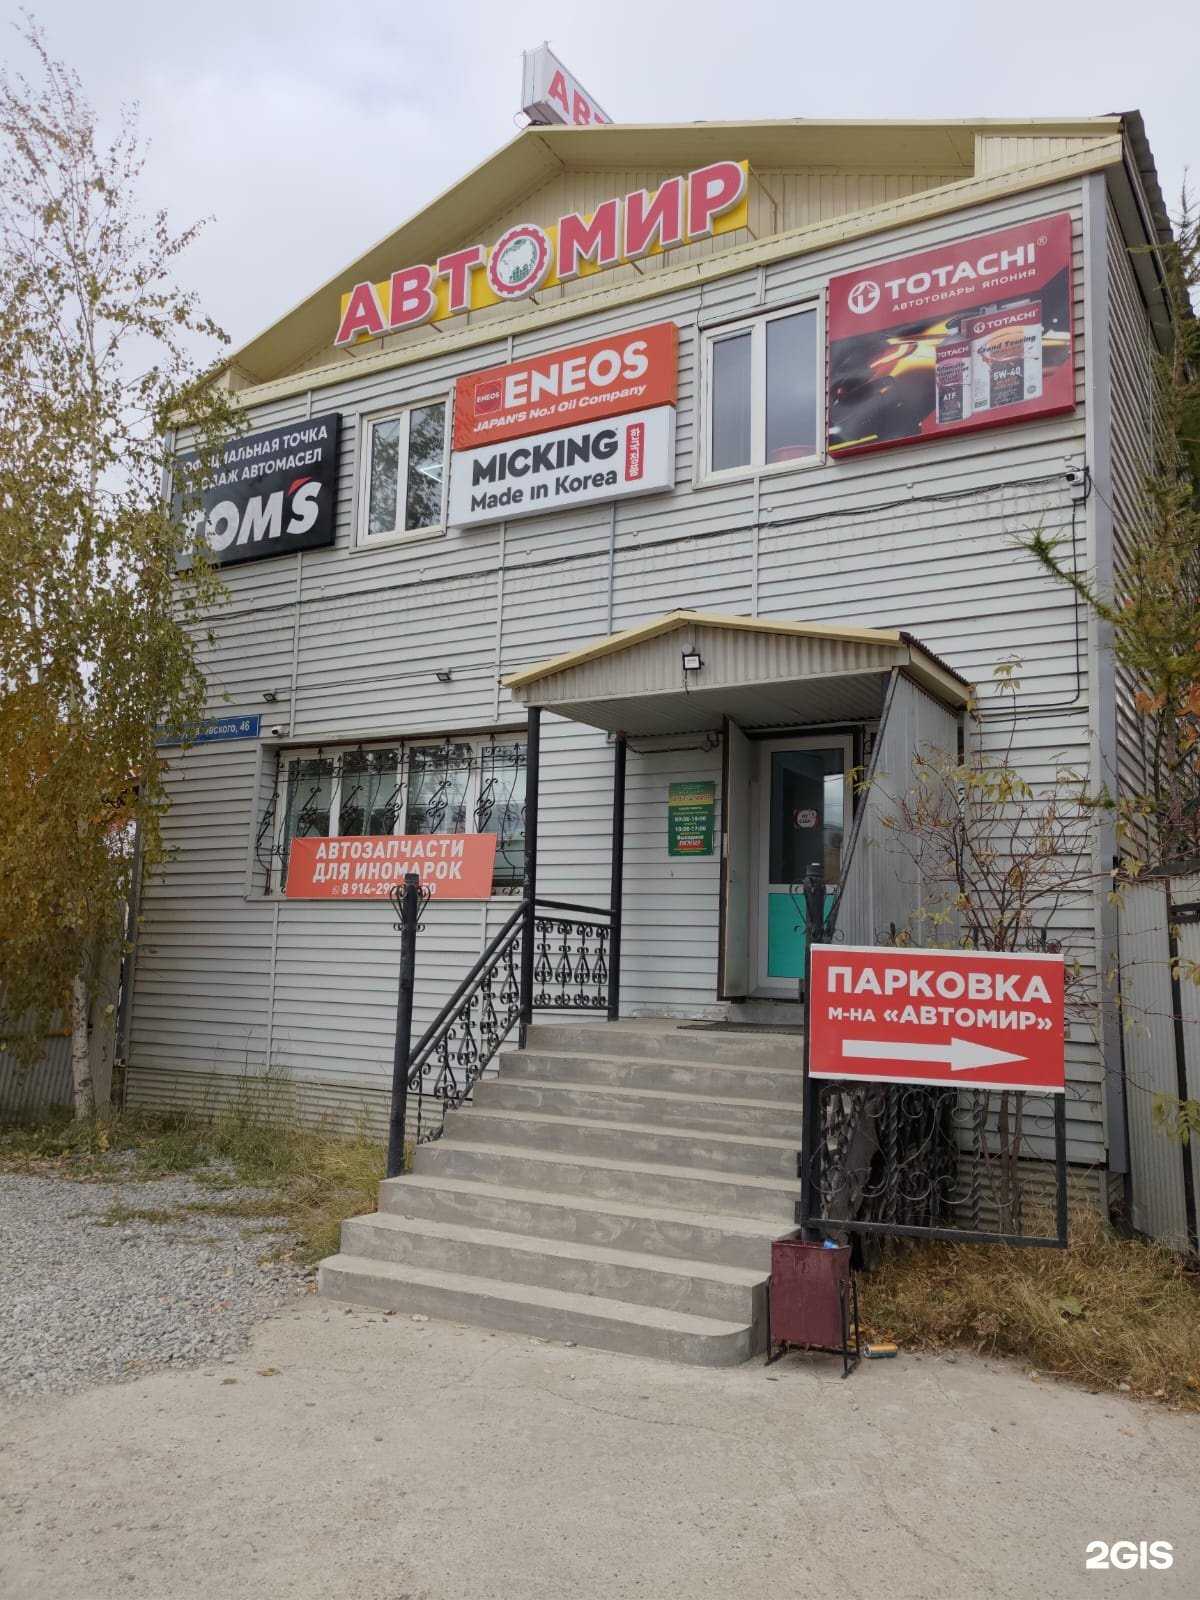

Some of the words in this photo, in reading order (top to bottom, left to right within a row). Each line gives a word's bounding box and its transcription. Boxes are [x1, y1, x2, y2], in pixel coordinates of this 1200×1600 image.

[547, 70, 605, 125] АВ
[333, 161, 748, 347] АВТОМИР
[885, 242, 1036, 300] TOTACHI
[892, 285, 975, 312] АВТОТОВАРЫ
[982, 268, 1036, 289] ЯПОНИЯ
[987, 310, 1037, 329] TOTACHI
[476, 391, 500, 403] ENEOS
[504, 340, 649, 409] ENEOS
[473, 411, 527, 432] JAPAN'S
[529, 405, 555, 419] No.1
[557, 400, 577, 411] Oil
[578, 385, 648, 408] Company
[183, 438, 279, 475] ОФЦИАЛЬНАЯ
[282, 425, 328, 449] ТОЧКА
[185, 469, 239, 494] ПОДАЖ
[241, 448, 322, 481] АВТОМАСЕЛ
[472, 429, 618, 487] MICKING
[470, 485, 524, 513] Made
[531, 483, 548, 500] in
[555, 469, 618, 496] Korea
[313, 862, 350, 884] ДЛЯ
[354, 860, 463, 880] ИНОМАРОК
[316, 839, 465, 860] АВТОЗАПЧАСТИ
[827, 965, 1053, 1004] ПАРКОВКА
[883, 1005, 1053, 1031] «АВТОМИР»
